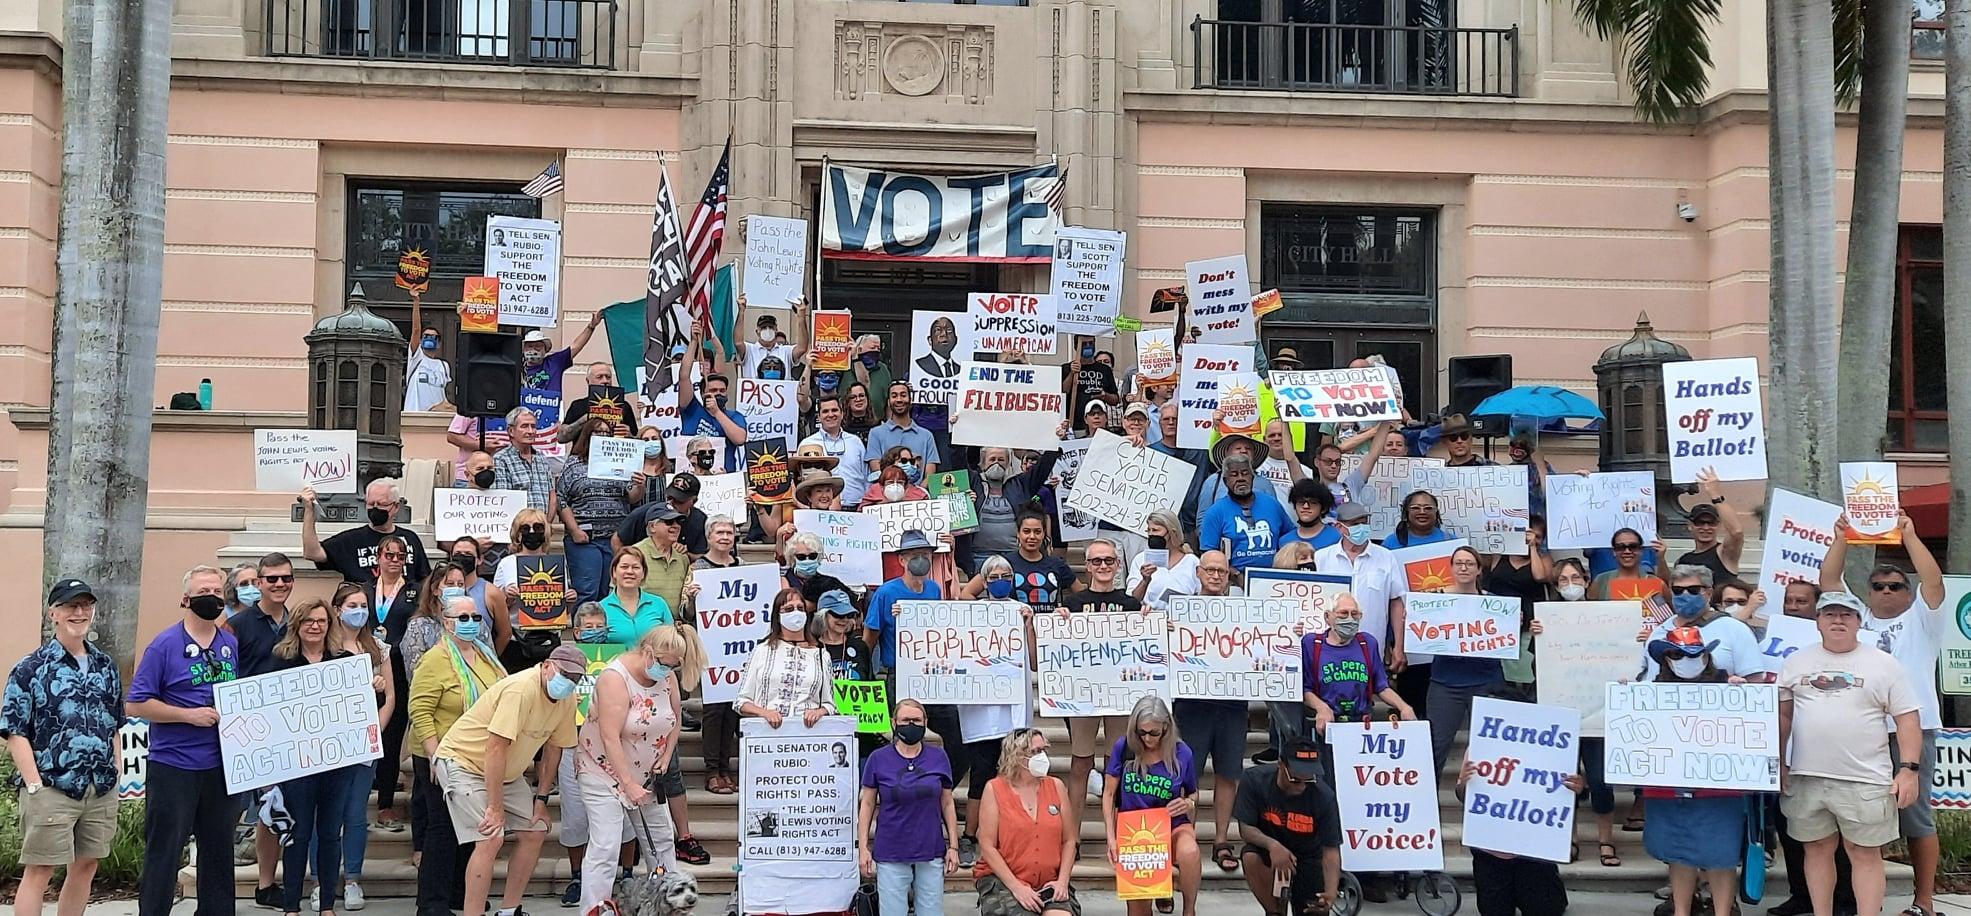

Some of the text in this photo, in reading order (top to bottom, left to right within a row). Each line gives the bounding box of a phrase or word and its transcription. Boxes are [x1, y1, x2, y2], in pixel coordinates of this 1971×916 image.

[829, 163, 1058, 257] VOTE
[508, 230, 552, 240] TELL SEN.
[754, 219, 802, 238] Pass the
[513, 242, 543, 250] RUBIO:
[750, 239, 802, 258] John Lewis
[1076, 242, 1095, 250] TELL
[501, 251, 543, 261] SUPPORT
[512, 261, 532, 270] THE
[748, 256, 803, 276] Voting Rights
[1066, 261, 1108, 271] SUPPORT
[497, 272, 546, 282] FREEDOM
[763, 276, 781, 286] Act
[1077, 271, 1097, 279] THE
[1198, 270, 1235, 285] Don't
[515, 283, 543, 292] VOTE
[1062, 281, 1110, 291] FREEDOM
[1202, 287, 1234, 299] mess
[510, 294, 531, 302] ACT
[978, 294, 1038, 316] VOTER
[1064, 292, 1106, 302] TO VOTE
[514, 305, 548, 315] 947-6288
[1074, 304, 1094, 312] ACT
[1193, 301, 1249, 317] with my
[1207, 318, 1240, 331] vote!
[982, 337, 1052, 353] UNAMERICAN
[1194, 358, 1239, 371] Don't
[969, 366, 1034, 384] END THE
[1272, 367, 1384, 386] FREEDOM
[920, 378, 959, 390] GOOD
[1195, 381, 1218, 390] me
[1278, 383, 1388, 402] TO VOTE
[1674, 376, 1753, 399] Hands
[525, 394, 559, 407] defend
[740, 380, 784, 409] PASS
[964, 389, 1062, 414] FILIBUSTER
[1335, 399, 1397, 417] NOW!
[1678, 408, 1754, 433] off my
[267, 432, 309, 442] Pass the
[282, 446, 309, 454] LEWIS
[1674, 436, 1756, 458] Ballot!
[303, 453, 350, 479] NOW!
[1116, 441, 1169, 474] CALL
[750, 471, 788, 480] FREEDOM
[765, 477, 787, 485] VOTE
[1115, 458, 1168, 492] YOUR
[1413, 467, 1525, 488] PROTECT
[1551, 480, 1594, 496] Voting
[450, 494, 508, 506] PROTECT
[1847, 503, 1896, 511] FREEDOM
[1872, 495, 1895, 503] THE
[443, 511, 465, 519] OUR
[890, 501, 944, 518] HERE
[1070, 489, 1148, 533] 202-224-31
[818, 513, 854, 526] PASS
[901, 517, 945, 532] GOOD
[1558, 515, 1601, 539] ALL
[464, 523, 508, 534] RIGHTS
[830, 526, 848, 535] THE
[1780, 519, 1833, 547] Protec
[1781, 548, 1822, 570] votin
[717, 579, 758, 601] My
[1271, 582, 1322, 599] STOP
[902, 603, 1020, 628] PROTECT
[1171, 598, 1299, 623] PROTECT
[1480, 598, 1520, 616] NOW!
[699, 609, 756, 630] Vote
[1036, 613, 1165, 639] PROTECT
[1409, 619, 1497, 641] VOTING
[899, 627, 1023, 660] REPUBLICANS
[1179, 625, 1293, 659] DEMOCRATS
[1460, 634, 1516, 653] RIGHTS
[1039, 639, 1160, 671] INDEPENDENTS
[218, 658, 371, 715] FREEDOM
[835, 683, 884, 703] VOTE
[908, 675, 1012, 700] RIGHTS
[1177, 671, 1296, 699] RIGHTS!
[1609, 684, 1774, 712] FREEDOM
[222, 693, 368, 748] TO VOTE
[1477, 716, 1572, 750] Hands
[1610, 715, 1767, 749] TO VOTE
[231, 724, 379, 785] ACT NOW!
[748, 743, 828, 755] TELL SENATOR
[1359, 733, 1406, 760] My
[773, 759, 811, 769] RUBIO:
[1607, 748, 1673, 777] ACT
[755, 775, 835, 786] PROTECT OUR
[1354, 765, 1418, 786] Vote
[1476, 757, 1520, 787] off
[756, 789, 801, 800] RIGHTS!
[787, 805, 836, 814] THE JOHN
[1365, 802, 1410, 823] my
[1468, 793, 1571, 828] Ballot!
[782, 816, 851, 826] LEWIS VOTING
[782, 829, 840, 838] RIGHTS ACT
[1346, 828, 1437, 850] Voice!
[749, 846, 847, 856] CALL (813) 947-6288
[1120, 844, 1168, 854] PASS THE
[1119, 853, 1169, 863] FREEDOM
[1122, 861, 1166, 871] TO VOTE
[1134, 870, 1154, 879] ACT
